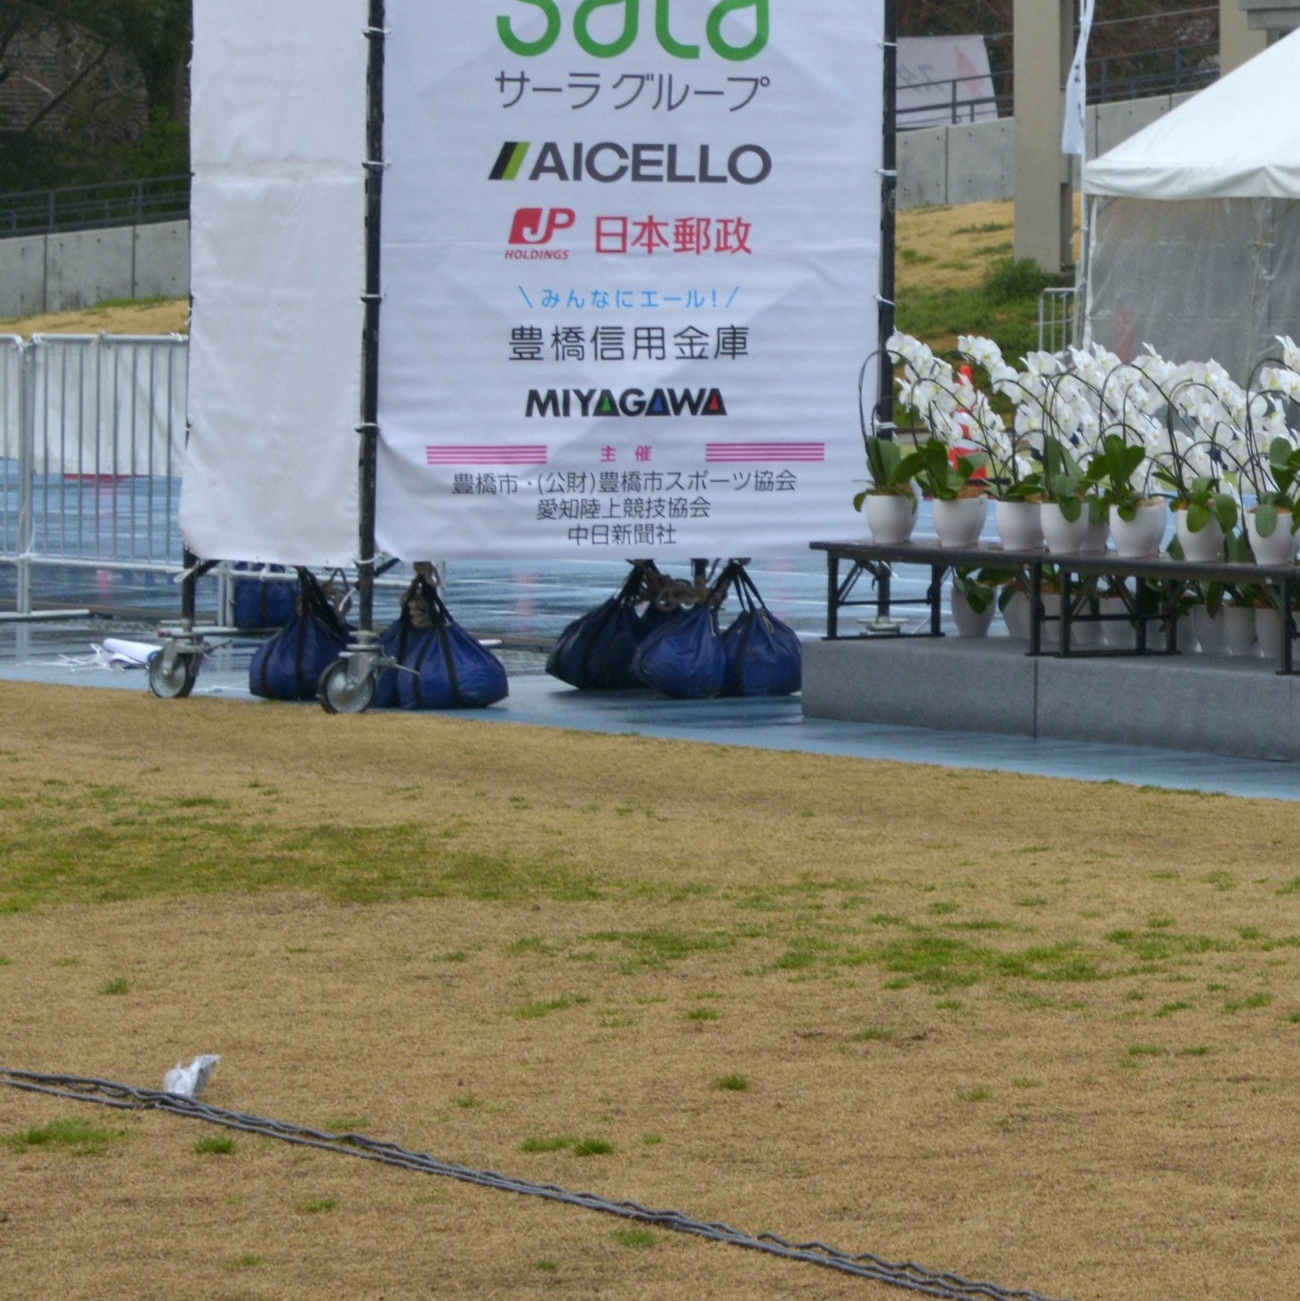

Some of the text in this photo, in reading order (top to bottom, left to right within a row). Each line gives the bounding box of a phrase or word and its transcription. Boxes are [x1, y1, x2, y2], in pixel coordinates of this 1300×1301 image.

[494, 70, 771, 113] サーラグループ
[528, 141, 773, 186] AICELLO
[508, 206, 577, 246] JP
[594, 215, 753, 255] 日本郵政
[504, 249, 570, 261] HOLDINGS
[508, 324, 750, 363] 豊橋信用金庫
[524, 387, 728, 418] MIYAGAWA
[601, 445, 652, 463] 主催
[536, 496, 712, 521] 愛知陸上競技協会
[567, 523, 678, 546] 中日新聞社
